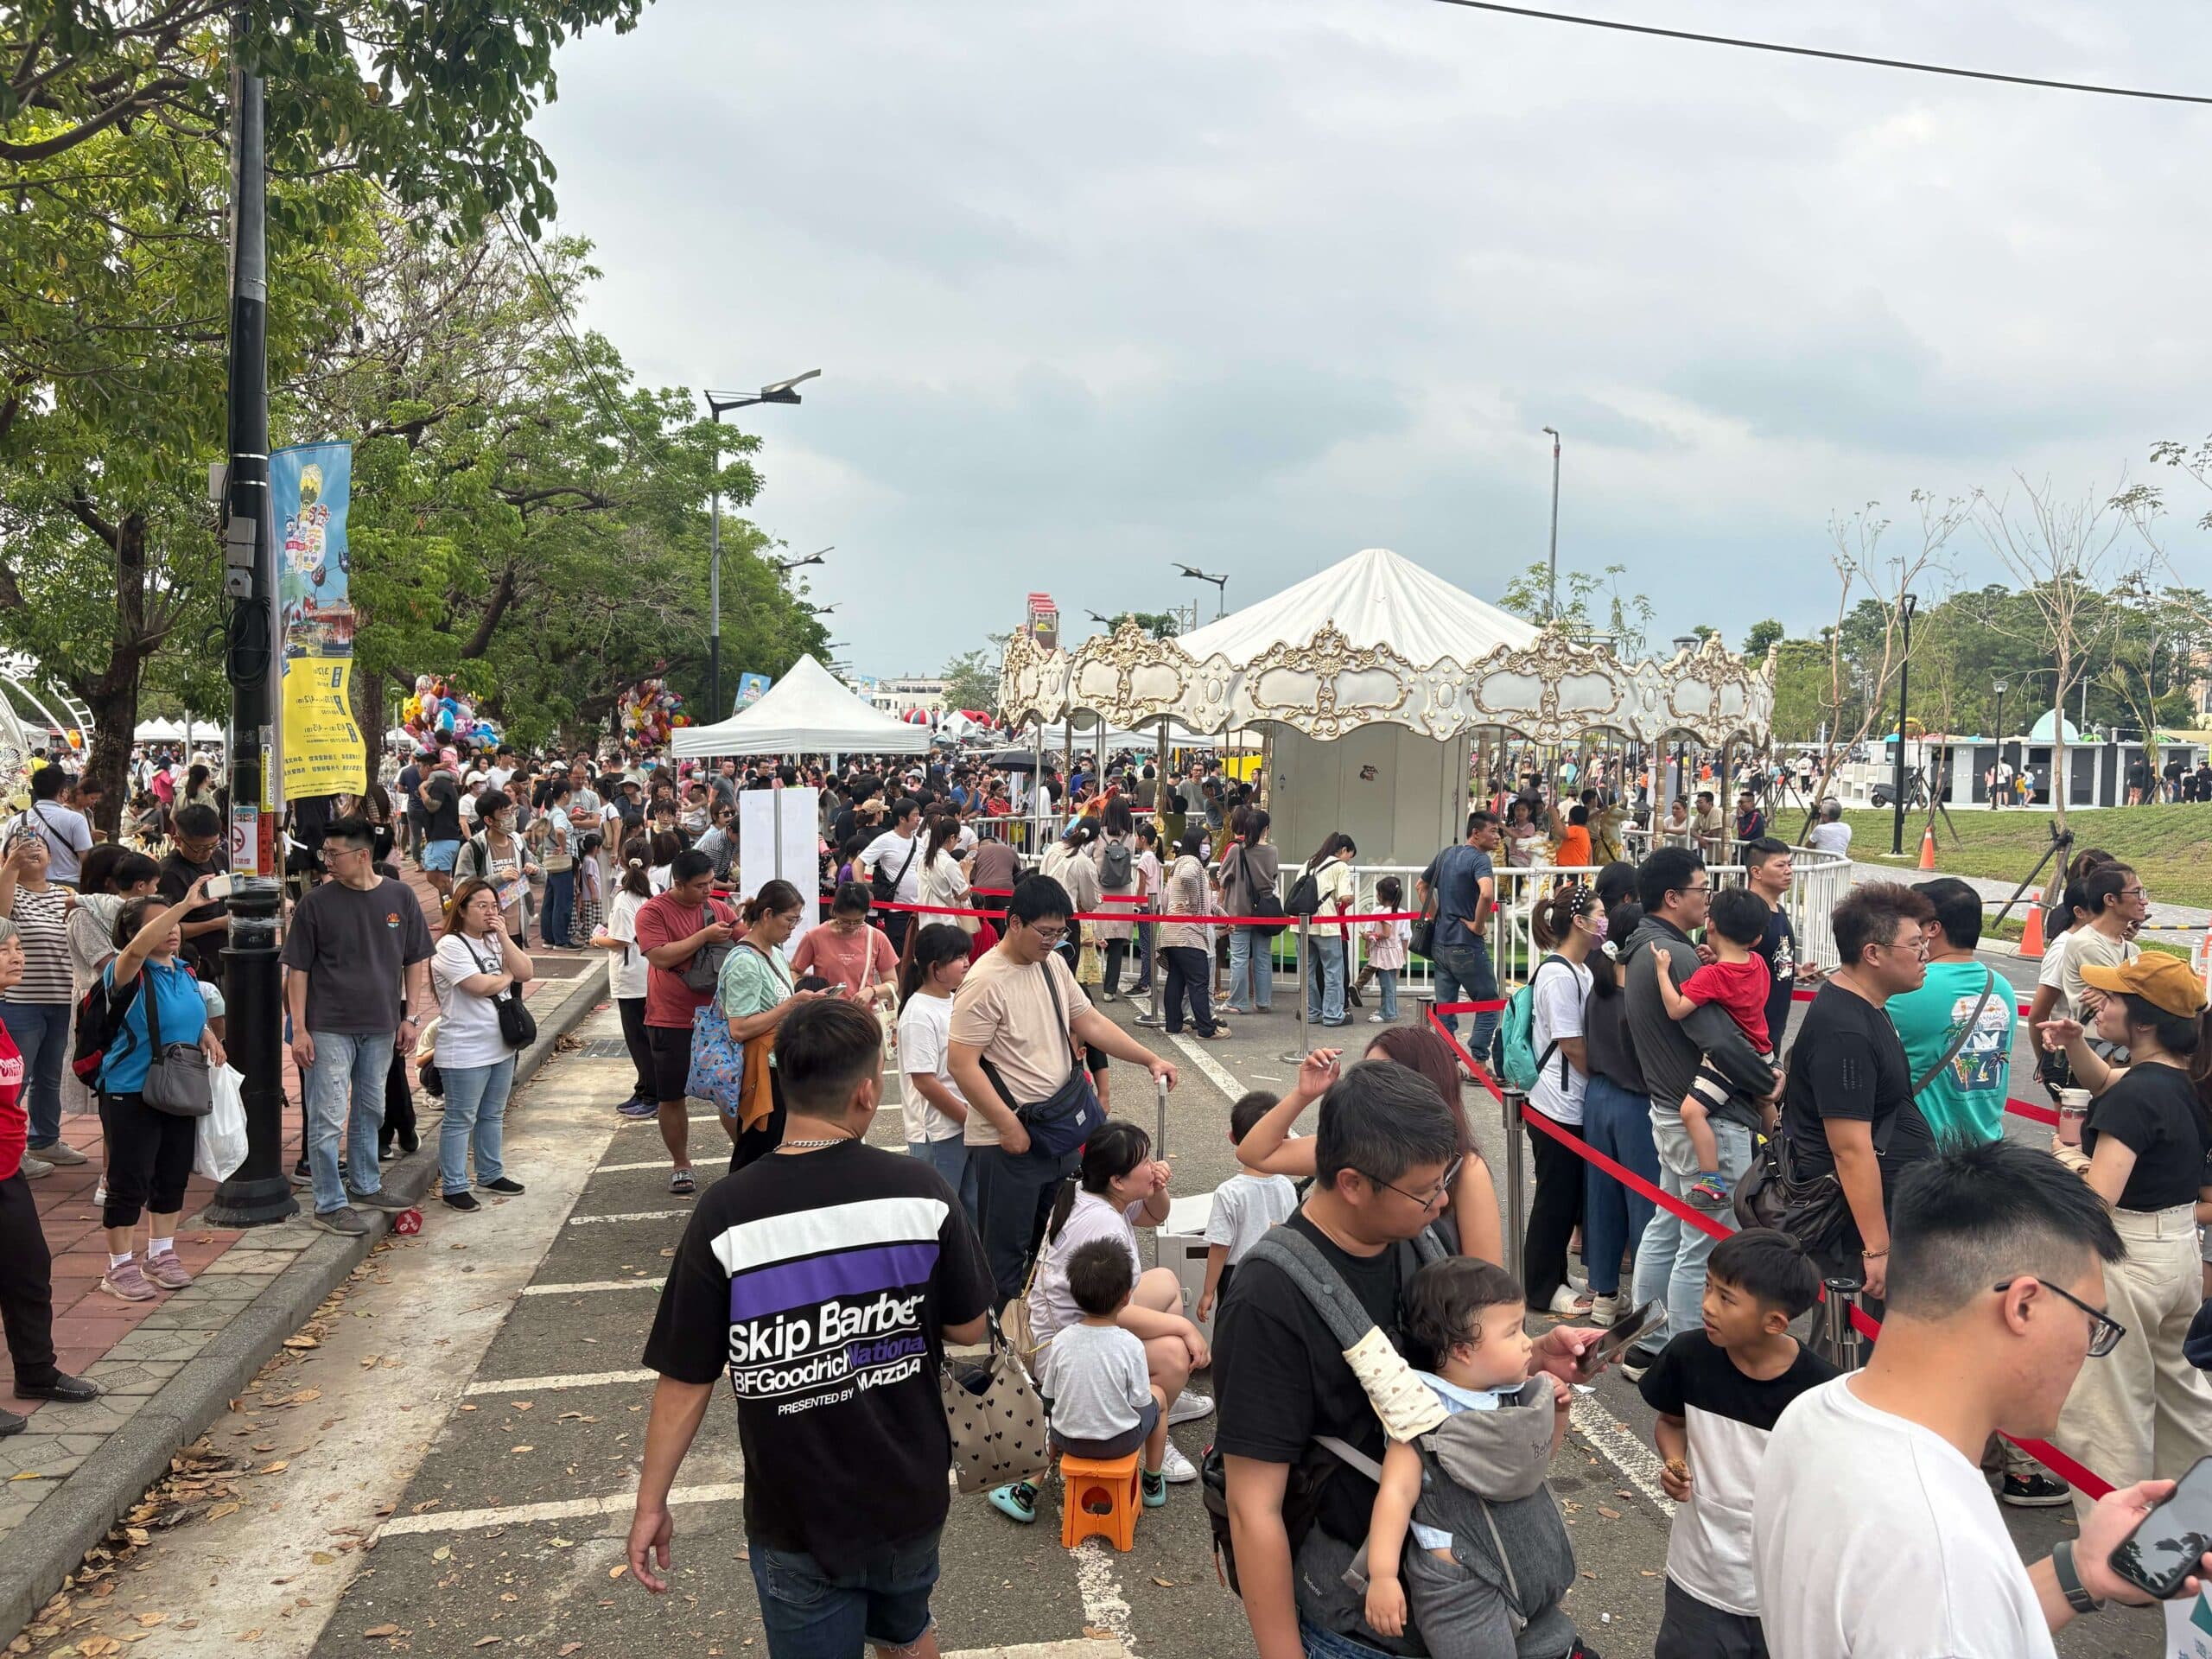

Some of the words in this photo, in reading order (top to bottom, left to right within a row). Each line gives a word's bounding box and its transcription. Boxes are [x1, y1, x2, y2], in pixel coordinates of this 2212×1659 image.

[728, 1314, 811, 1363] Skip
[818, 1293, 925, 1345] Barber
[847, 1336, 926, 1368] Nationa
[778, 1392, 840, 1416] PRESENTED
[840, 1387, 855, 1402] BY
